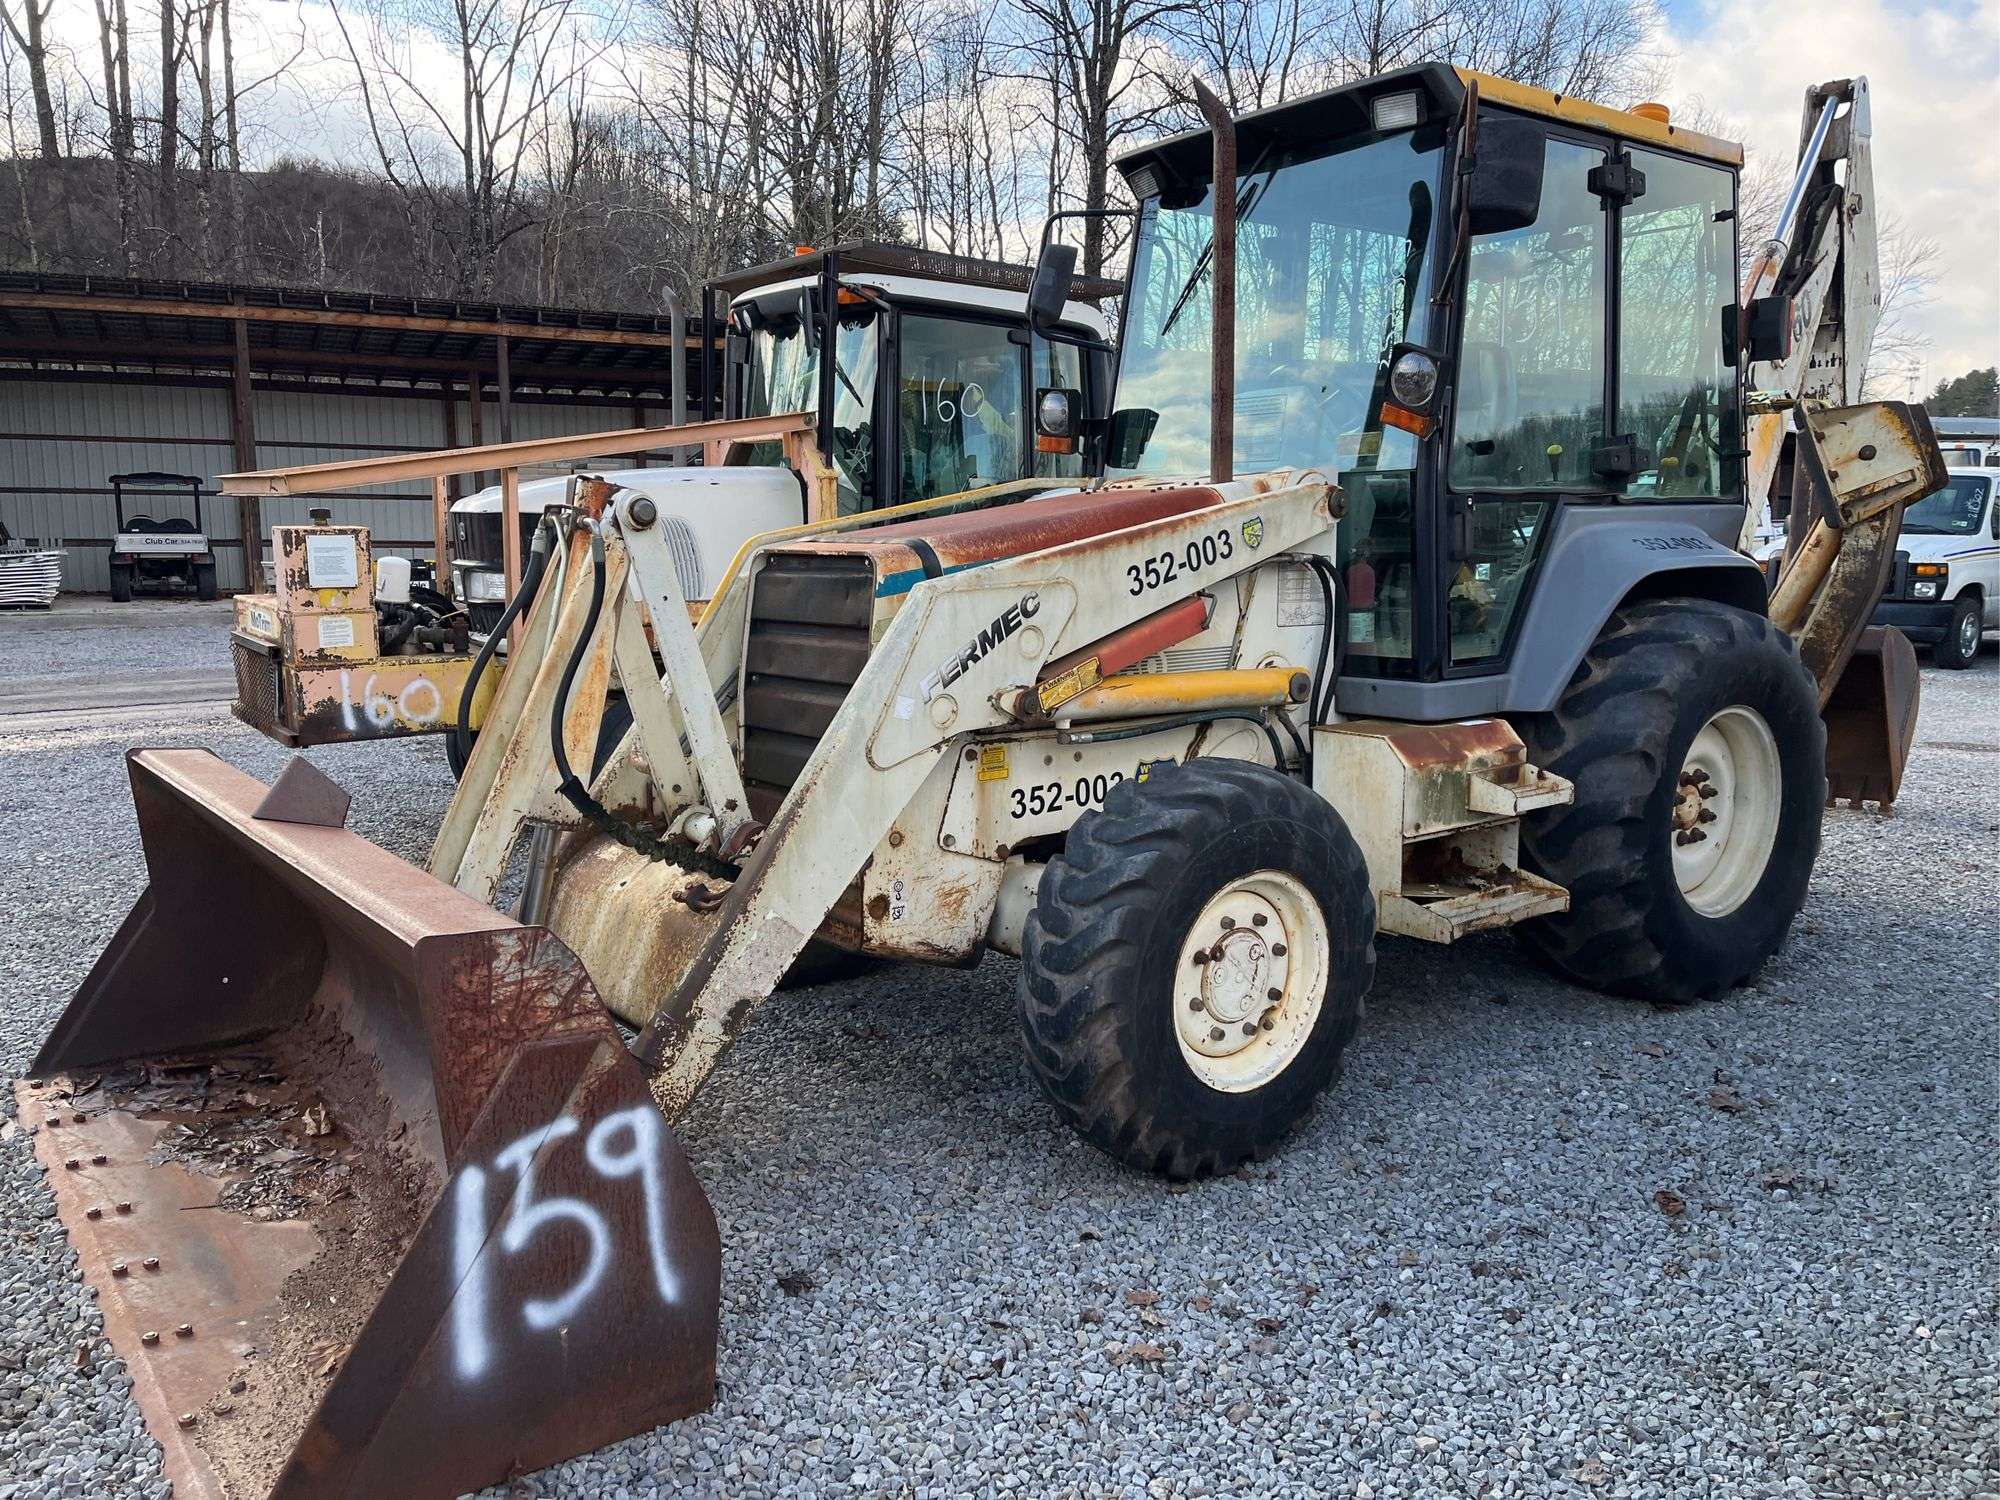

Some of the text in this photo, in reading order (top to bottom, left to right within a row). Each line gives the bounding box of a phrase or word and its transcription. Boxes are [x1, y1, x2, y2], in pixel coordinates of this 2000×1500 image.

[922, 375, 985, 425] 160
[1126, 529, 1234, 596] 352-003
[920, 591, 1041, 705] FERMEC
[339, 671, 443, 733] 160
[455, 1105, 681, 1380] 159
